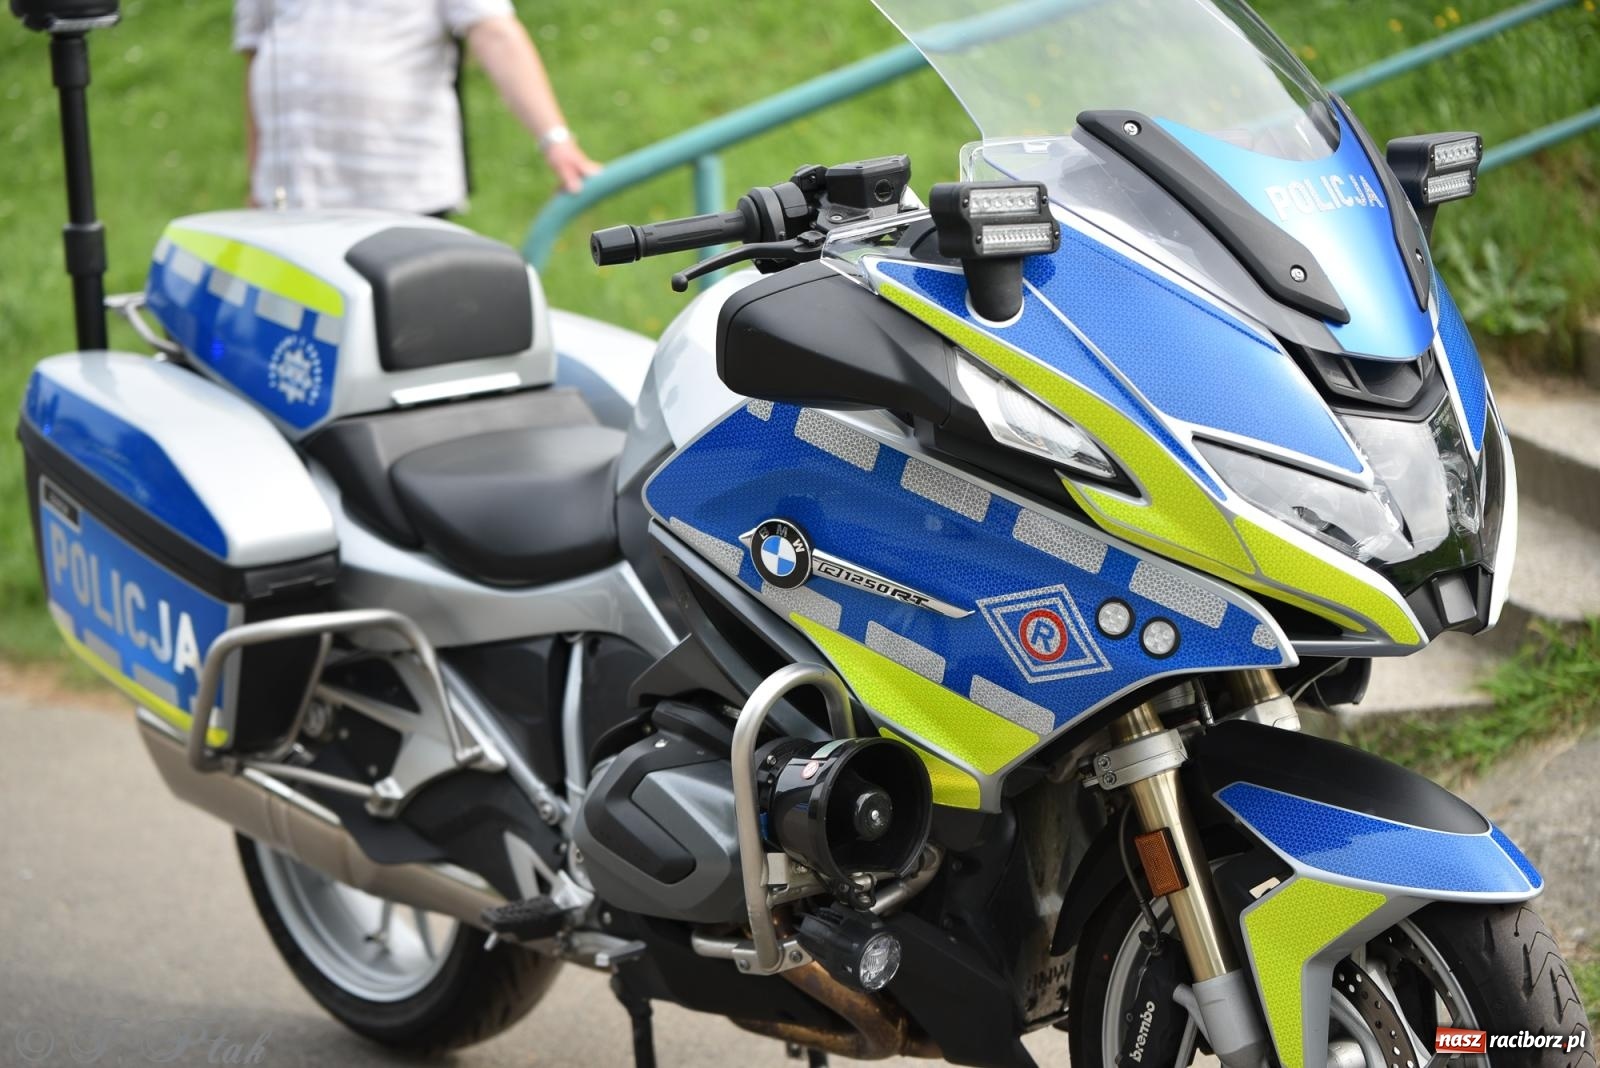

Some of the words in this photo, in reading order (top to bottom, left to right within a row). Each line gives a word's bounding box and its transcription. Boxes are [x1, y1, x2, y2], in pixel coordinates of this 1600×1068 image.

[1264, 174, 1385, 222] POLICJA
[758, 523, 806, 554] BMW
[49, 523, 202, 676] POLICJA
[1030, 618, 1055, 653] R
[1129, 1000, 1156, 1063] brembo
